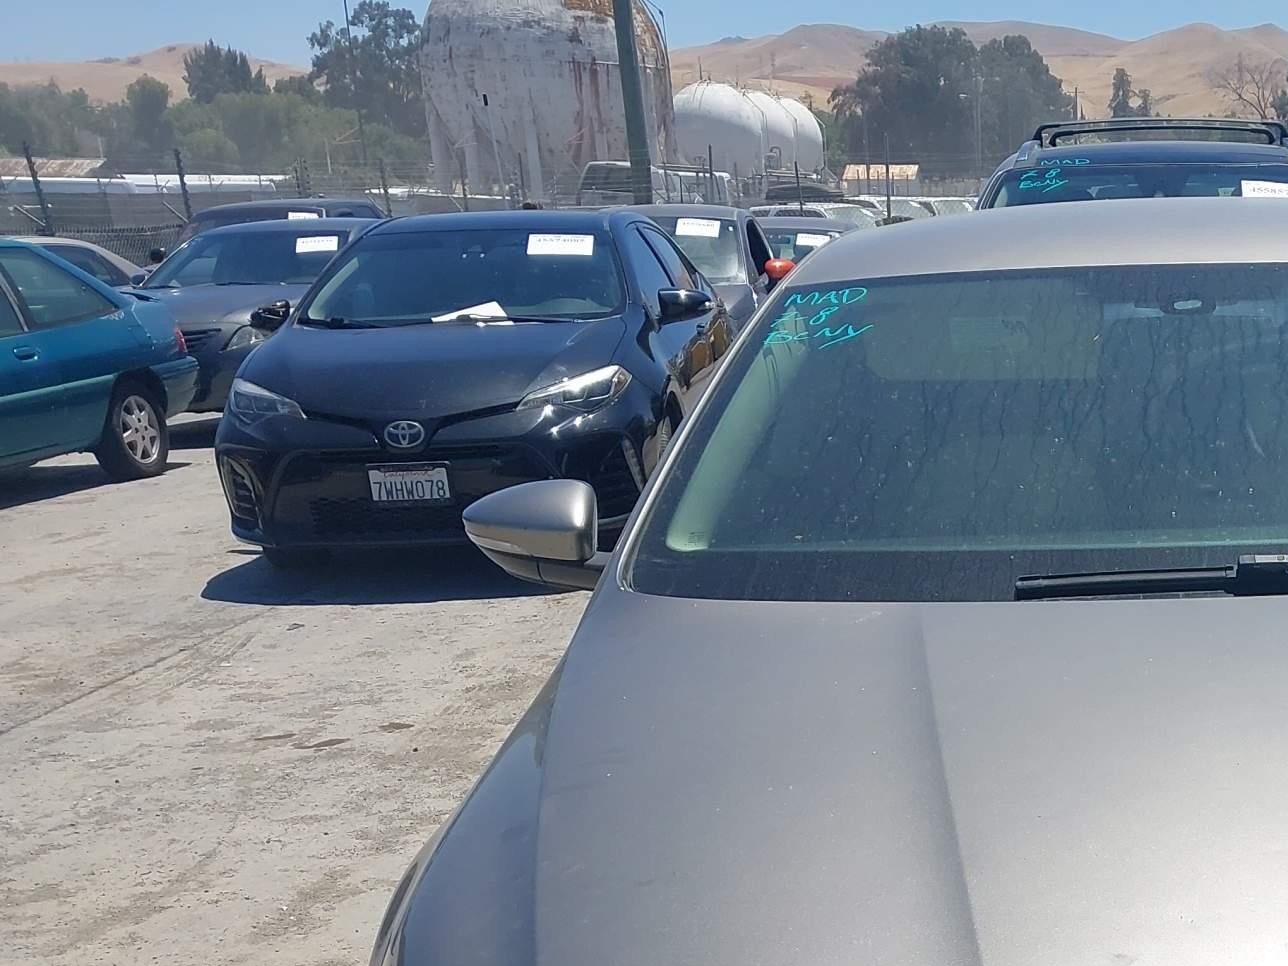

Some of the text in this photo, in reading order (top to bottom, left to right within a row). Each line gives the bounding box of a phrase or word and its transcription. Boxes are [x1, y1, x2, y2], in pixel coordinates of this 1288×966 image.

[1041, 158, 1091, 167] MAD
[784, 287, 868, 307] MAD
[372, 479, 446, 500] 7WHW078
